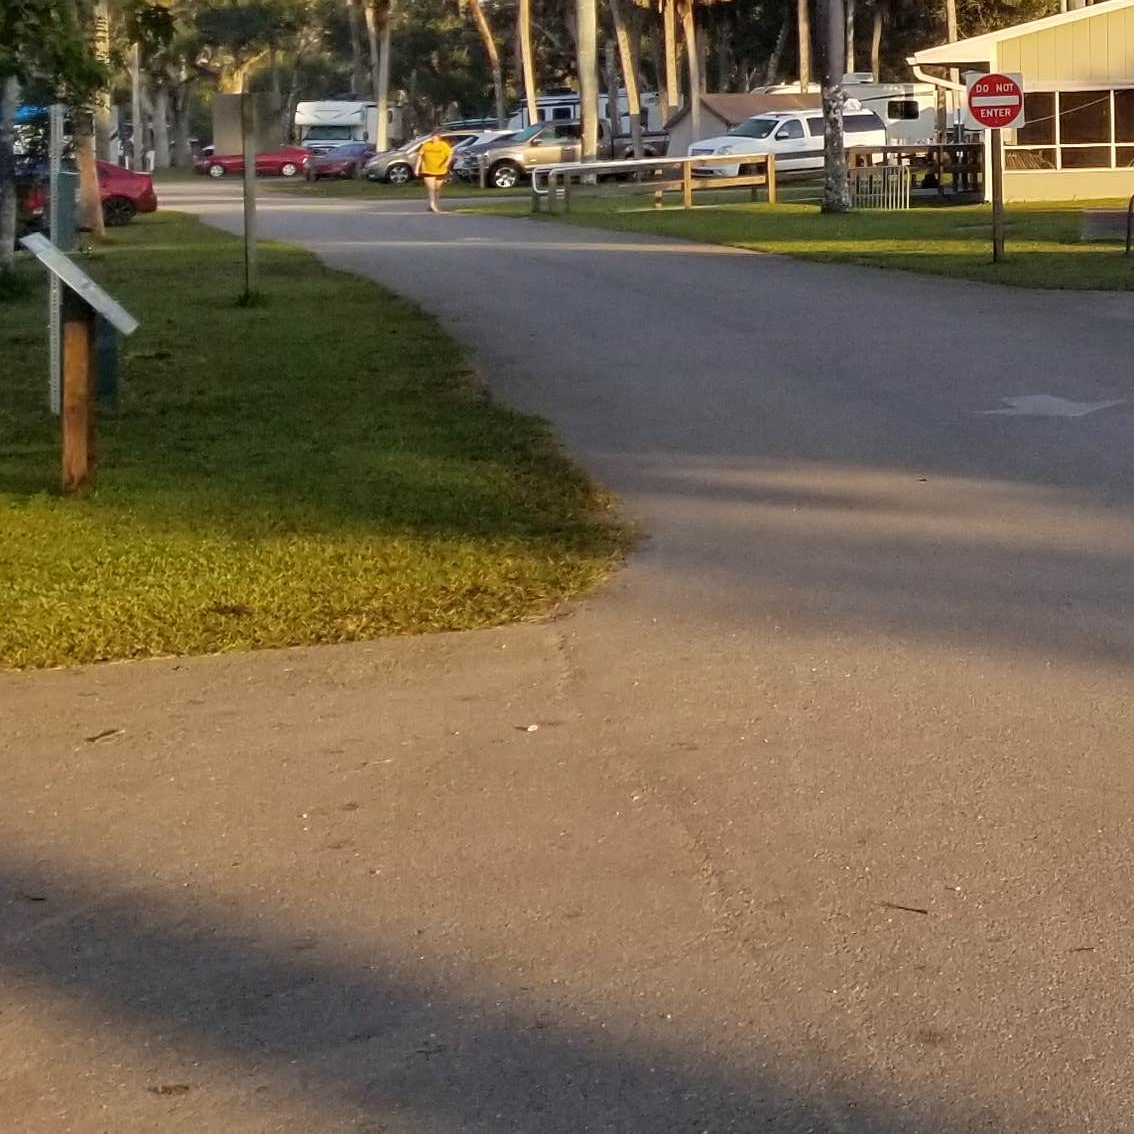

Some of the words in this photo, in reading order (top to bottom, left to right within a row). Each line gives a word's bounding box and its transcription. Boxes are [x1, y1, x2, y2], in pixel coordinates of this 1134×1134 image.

[976, 84, 989, 93] DO
[996, 82, 1013, 92] NOT
[980, 108, 1011, 118] ENTER
